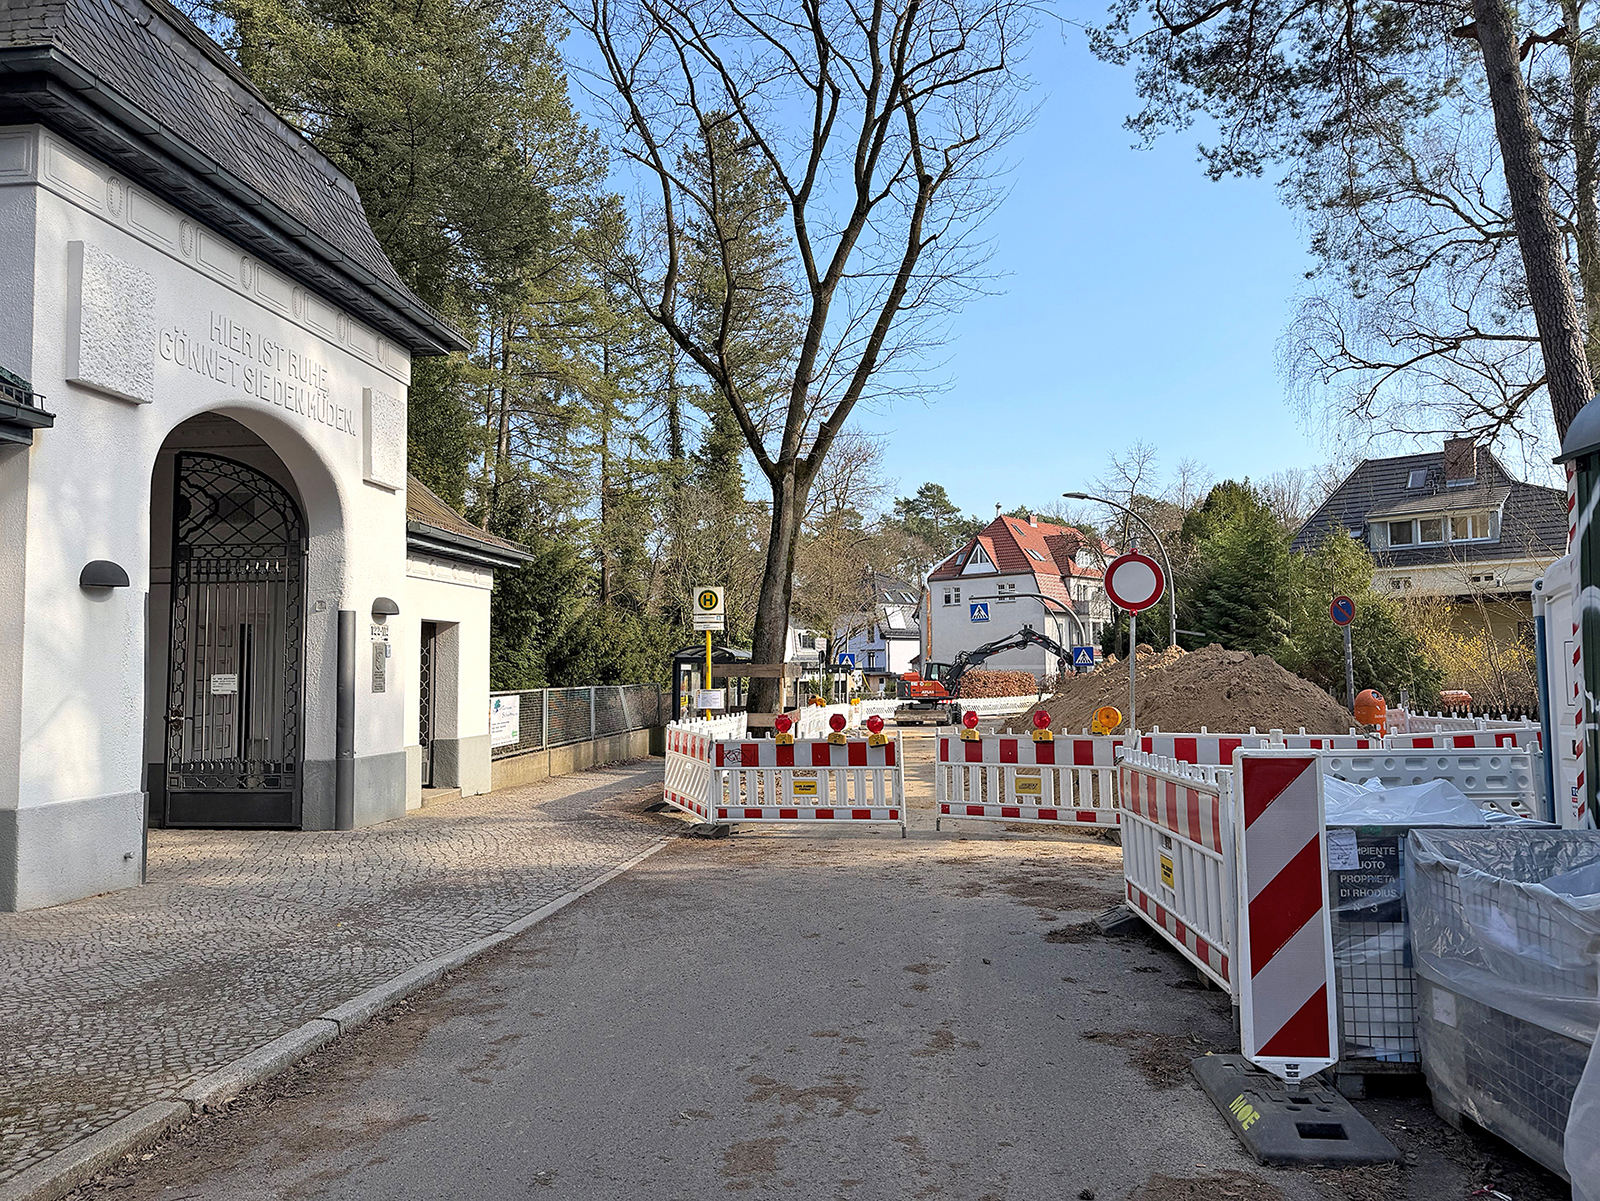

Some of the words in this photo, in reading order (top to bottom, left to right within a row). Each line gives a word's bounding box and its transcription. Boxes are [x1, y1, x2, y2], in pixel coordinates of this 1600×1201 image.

[210, 310, 253, 359] HIER
[258, 333, 285, 371] IST
[288, 348, 330, 397] RUHE,
[159, 325, 240, 388] GÖNNET
[243, 363, 271, 402] SIE
[273, 376, 305, 416] DEN
[307, 389, 356, 437] MÜDEN.
[703, 594, 713, 606] H
[1340, 888, 1350, 897] DI
[1352, 888, 1397, 898] RHODIUS
[1370, 902, 1379, 913] 3
[1228, 1093, 1260, 1131] MOE
